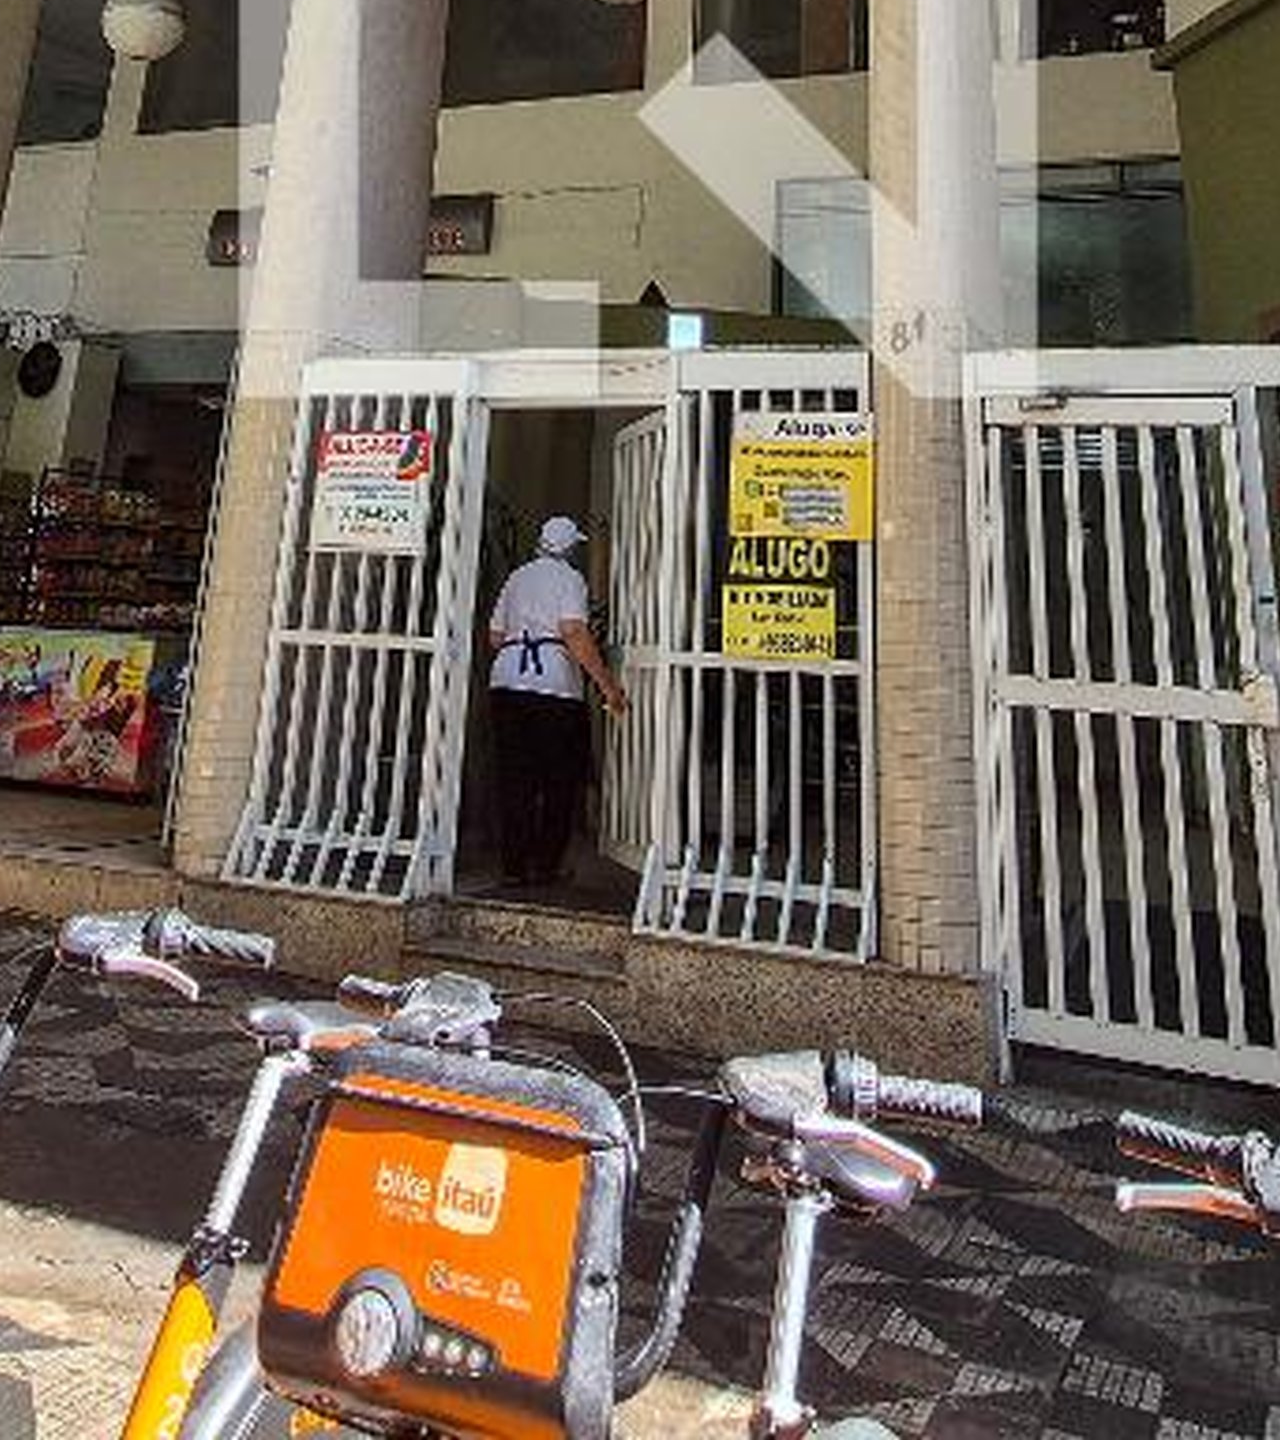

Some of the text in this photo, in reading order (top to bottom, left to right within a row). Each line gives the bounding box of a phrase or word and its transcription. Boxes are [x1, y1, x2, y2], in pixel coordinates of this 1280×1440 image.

[728, 538, 831, 578] ALUGO
[376, 1160, 432, 1203] bike
[439, 1175, 497, 1220] itaú
